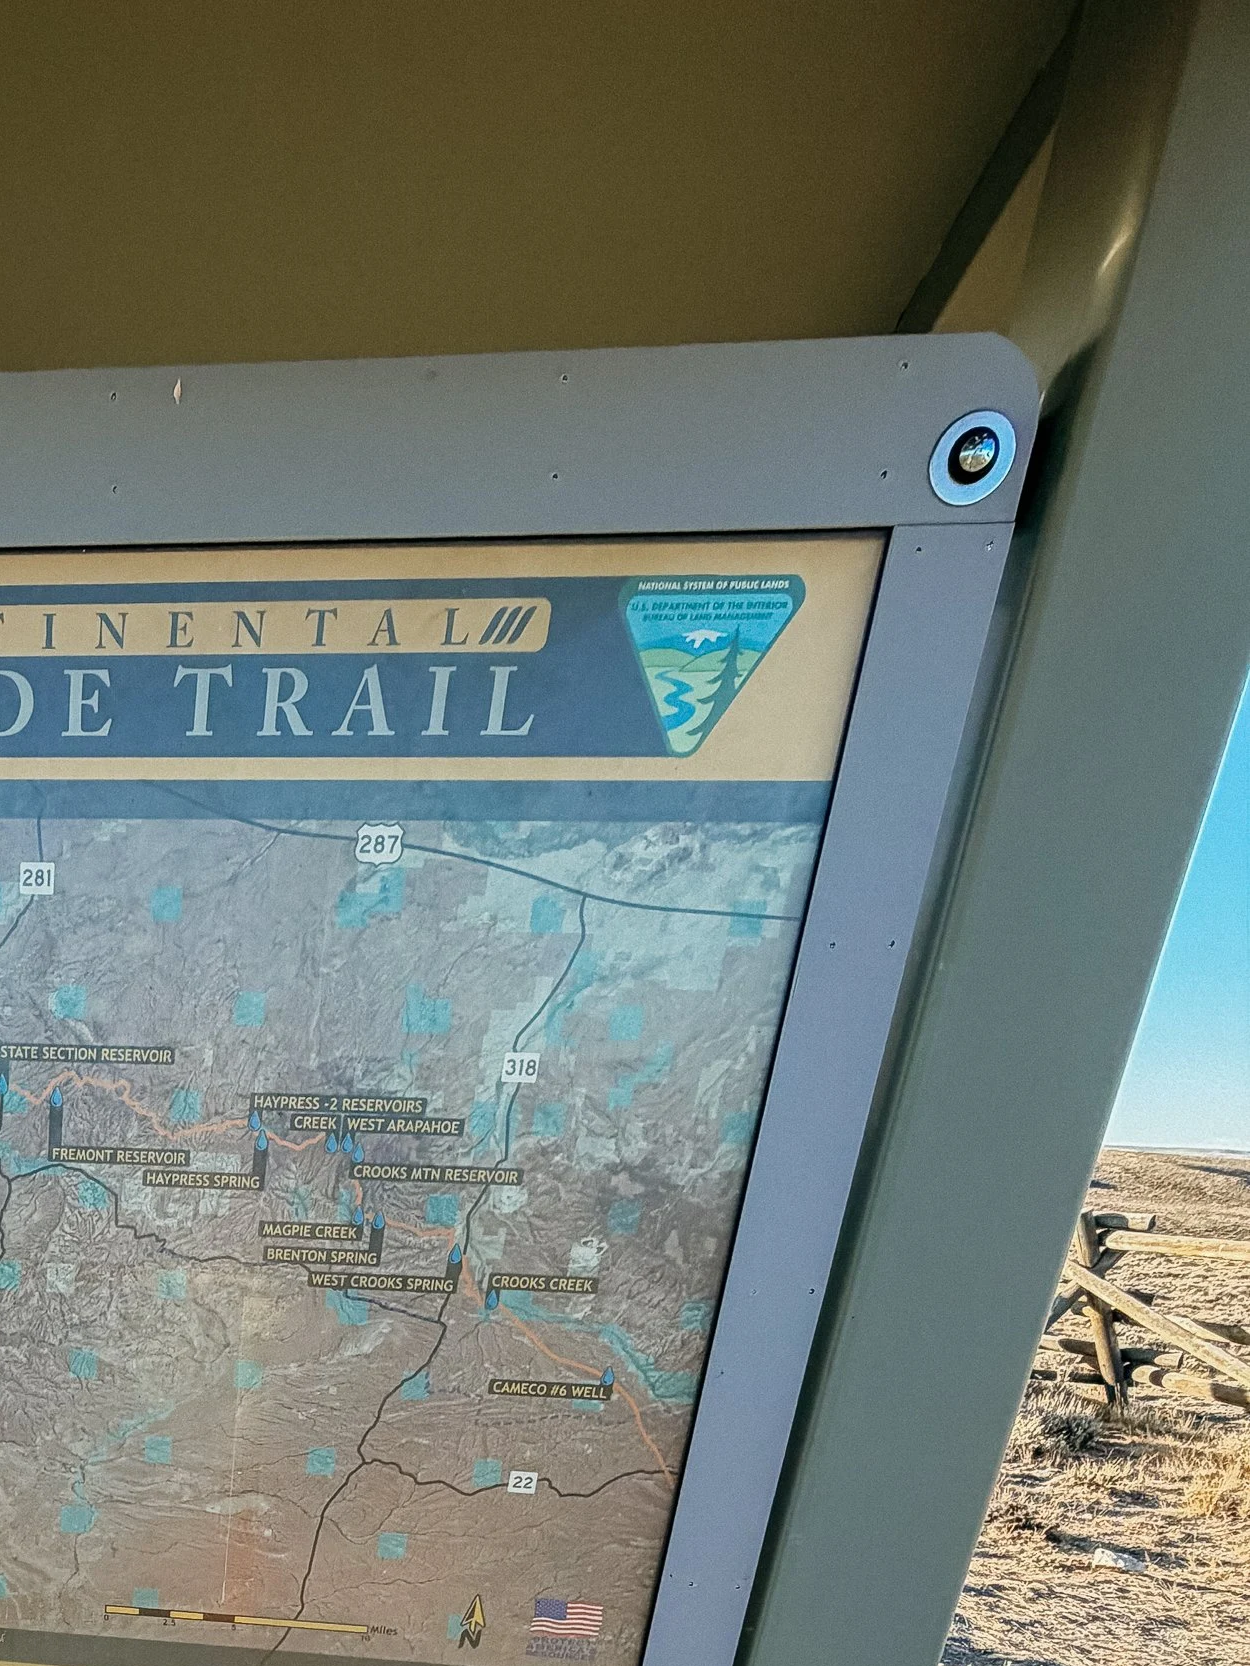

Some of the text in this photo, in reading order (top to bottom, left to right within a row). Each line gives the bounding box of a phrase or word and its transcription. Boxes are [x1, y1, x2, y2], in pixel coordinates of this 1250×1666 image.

[638, 580, 790, 590] NATIONAL SYSTEM OF PUBLIC LANDS
[173, 663, 535, 737] TRAIL
[360, 835, 399, 853] 287
[23, 869, 51, 886] 281
[1, 1046, 172, 1062] STATE SECTION RESERVOIR
[505, 1059, 536, 1076] 318
[254, 1096, 320, 1110] HAYPRESS
[342, 1098, 423, 1113] RESERVOIRS
[294, 1117, 337, 1129] CREEK
[347, 1119, 460, 1134] WEST ARAPAHOE
[52, 1148, 185, 1164] FREMONT RESERVOIR
[146, 1173, 260, 1188] HAYPRESS SPRING
[354, 1165, 518, 1183] CROOKS MTN RESERVOIR
[263, 1224, 357, 1239] MAGPIE CREEK
[267, 1249, 377, 1264] BRENTON SPRING
[312, 1274, 453, 1291] WEST CROOKS SPRING
[492, 1276, 593, 1291] CROOKS CREEK
[493, 1381, 606, 1398] CAMECO #6 WELL
[513, 1476, 533, 1488] 22
[370, 1626, 398, 1636] Miles
